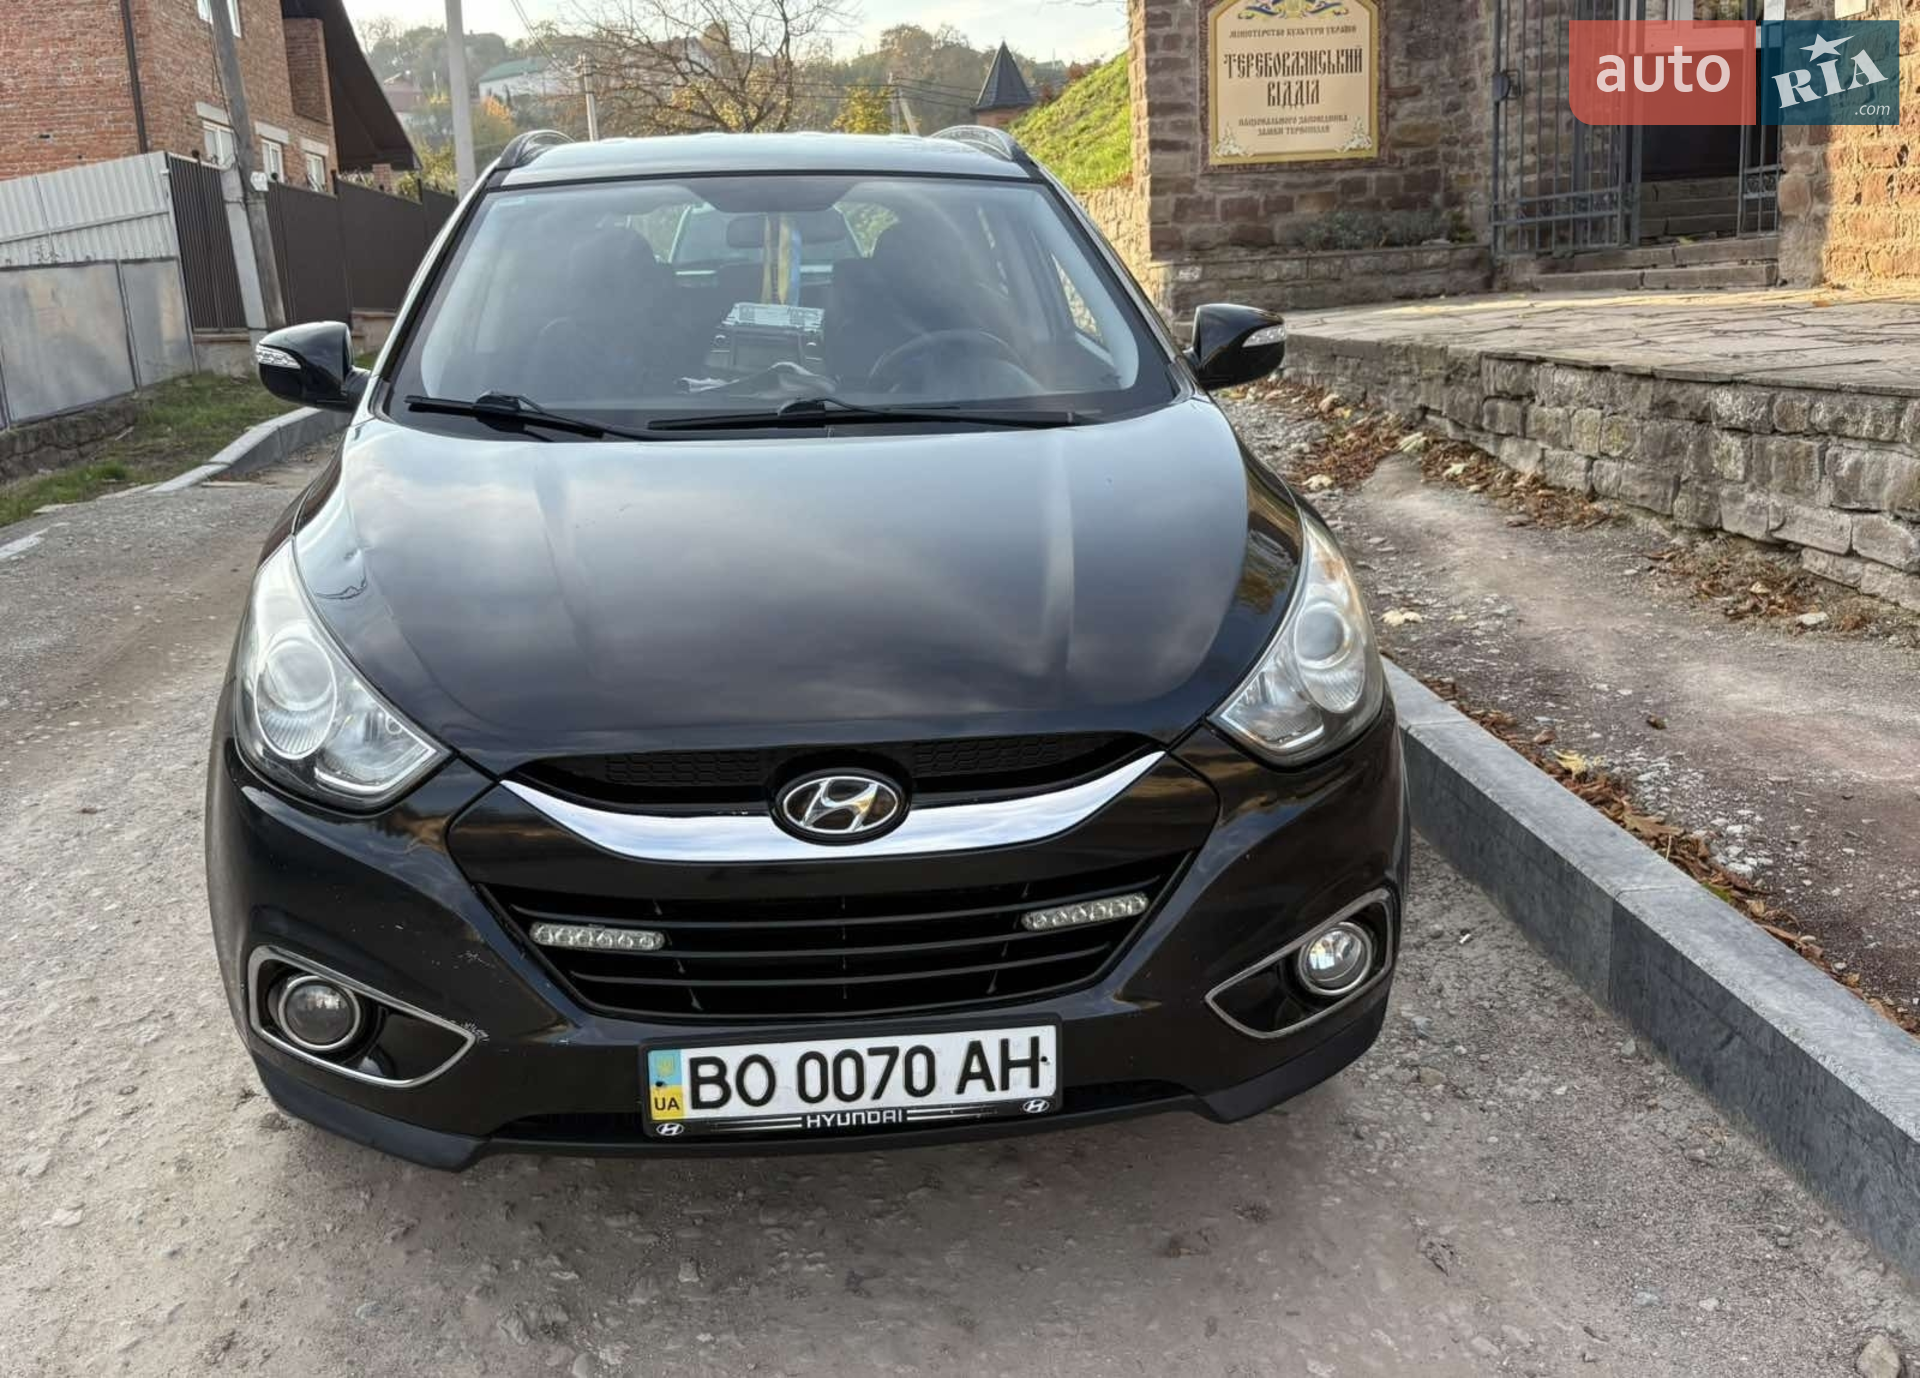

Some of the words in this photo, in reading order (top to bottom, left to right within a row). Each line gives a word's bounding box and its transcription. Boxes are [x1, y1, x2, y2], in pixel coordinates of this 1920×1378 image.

[1223, 45, 1363, 79] ТЕРЕБОВЛЯНСЬКИЙ
[1267, 79, 1320, 108] ВІДДІЛ
[689, 1054, 777, 1110] BO
[796, 1045, 936, 1104] 0070
[956, 1035, 1041, 1095] AH
[654, 1097, 680, 1111] UA
[806, 1108, 903, 1129] HYUNDAI
